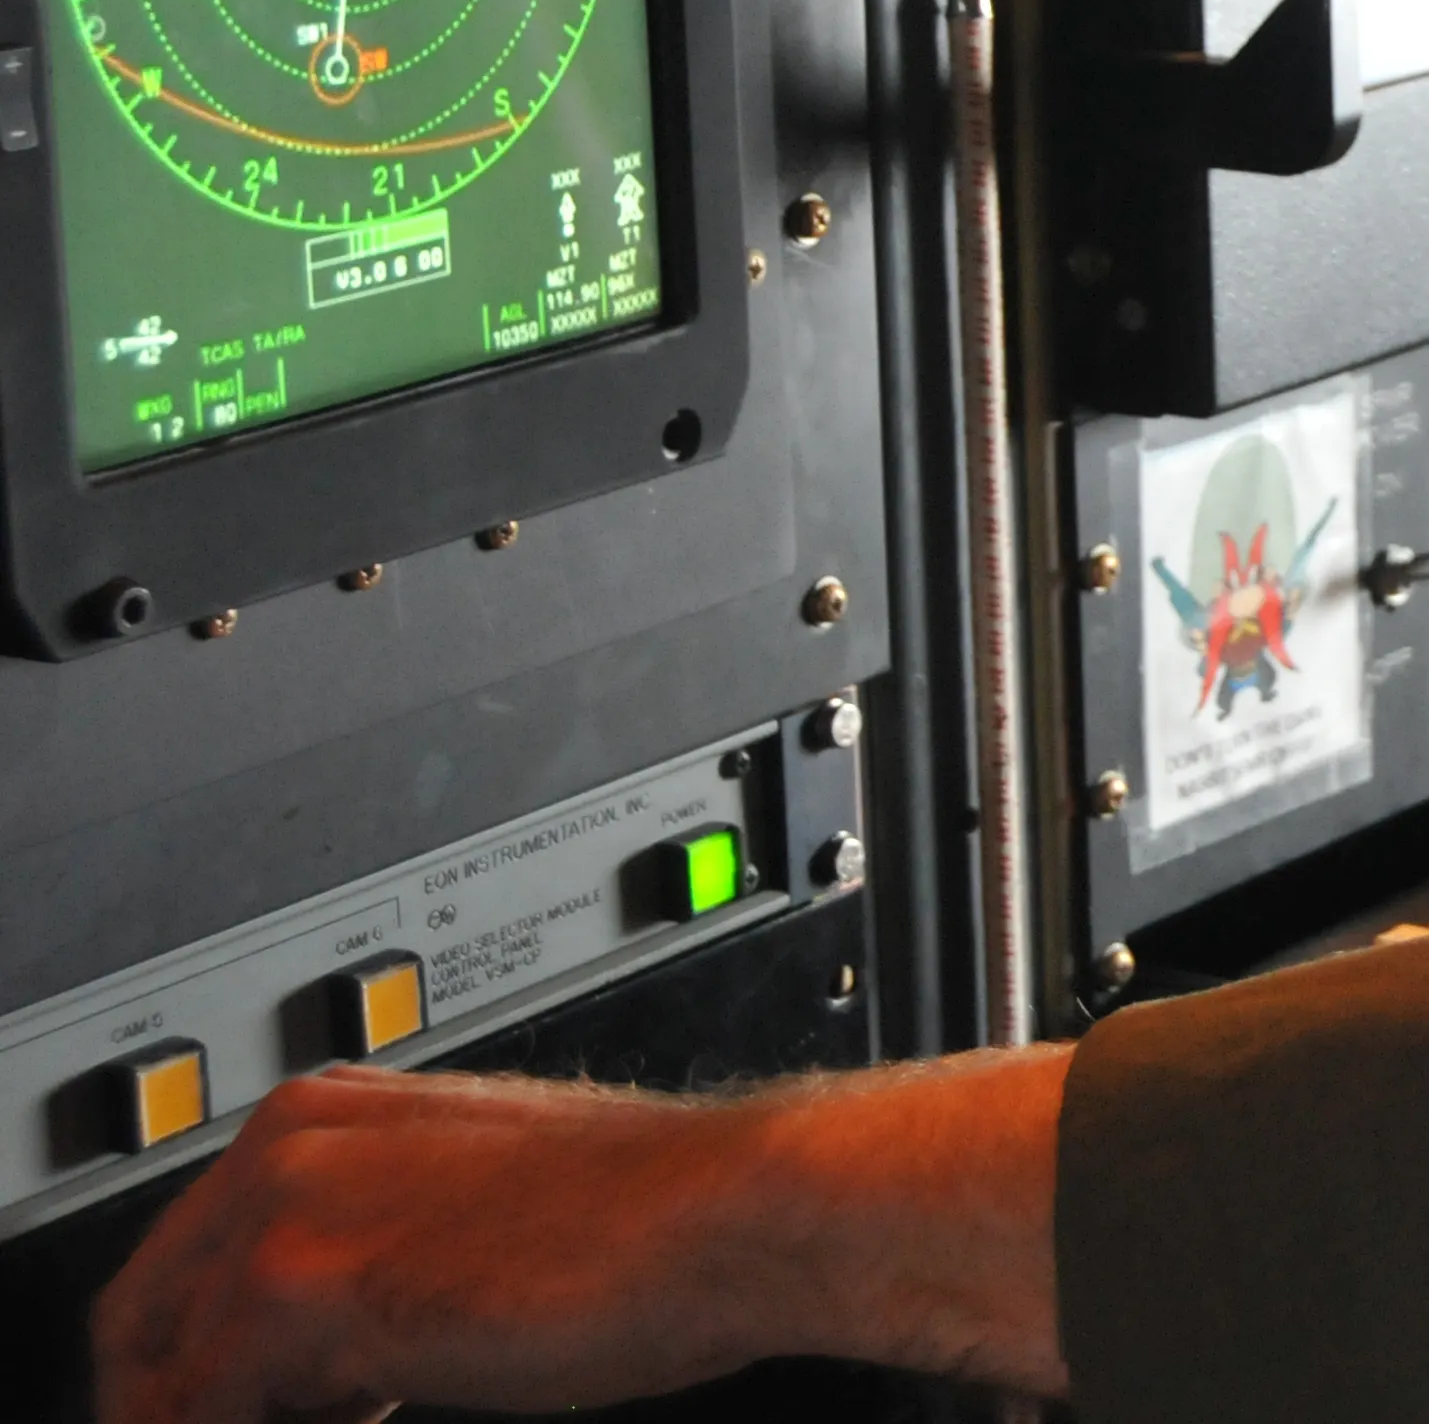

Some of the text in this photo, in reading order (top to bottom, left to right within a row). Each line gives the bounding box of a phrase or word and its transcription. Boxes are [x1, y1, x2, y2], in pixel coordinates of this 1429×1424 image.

[493, 88, 510, 117] S
[243, 157, 279, 191] 24
[371, 164, 404, 196] 21
[493, 320, 539, 350] 10350
[201, 339, 245, 367] TCAS
[660, 797, 708, 827] POWER
[424, 868, 459, 895] EON
[430, 887, 602, 969] VIDEO SELECTOR MODULE
[335, 932, 369, 956] CAM
[431, 932, 544, 987] CONTROL PANEL
[431, 976, 481, 1005] MODEL
[110, 1020, 148, 1044] CAM
